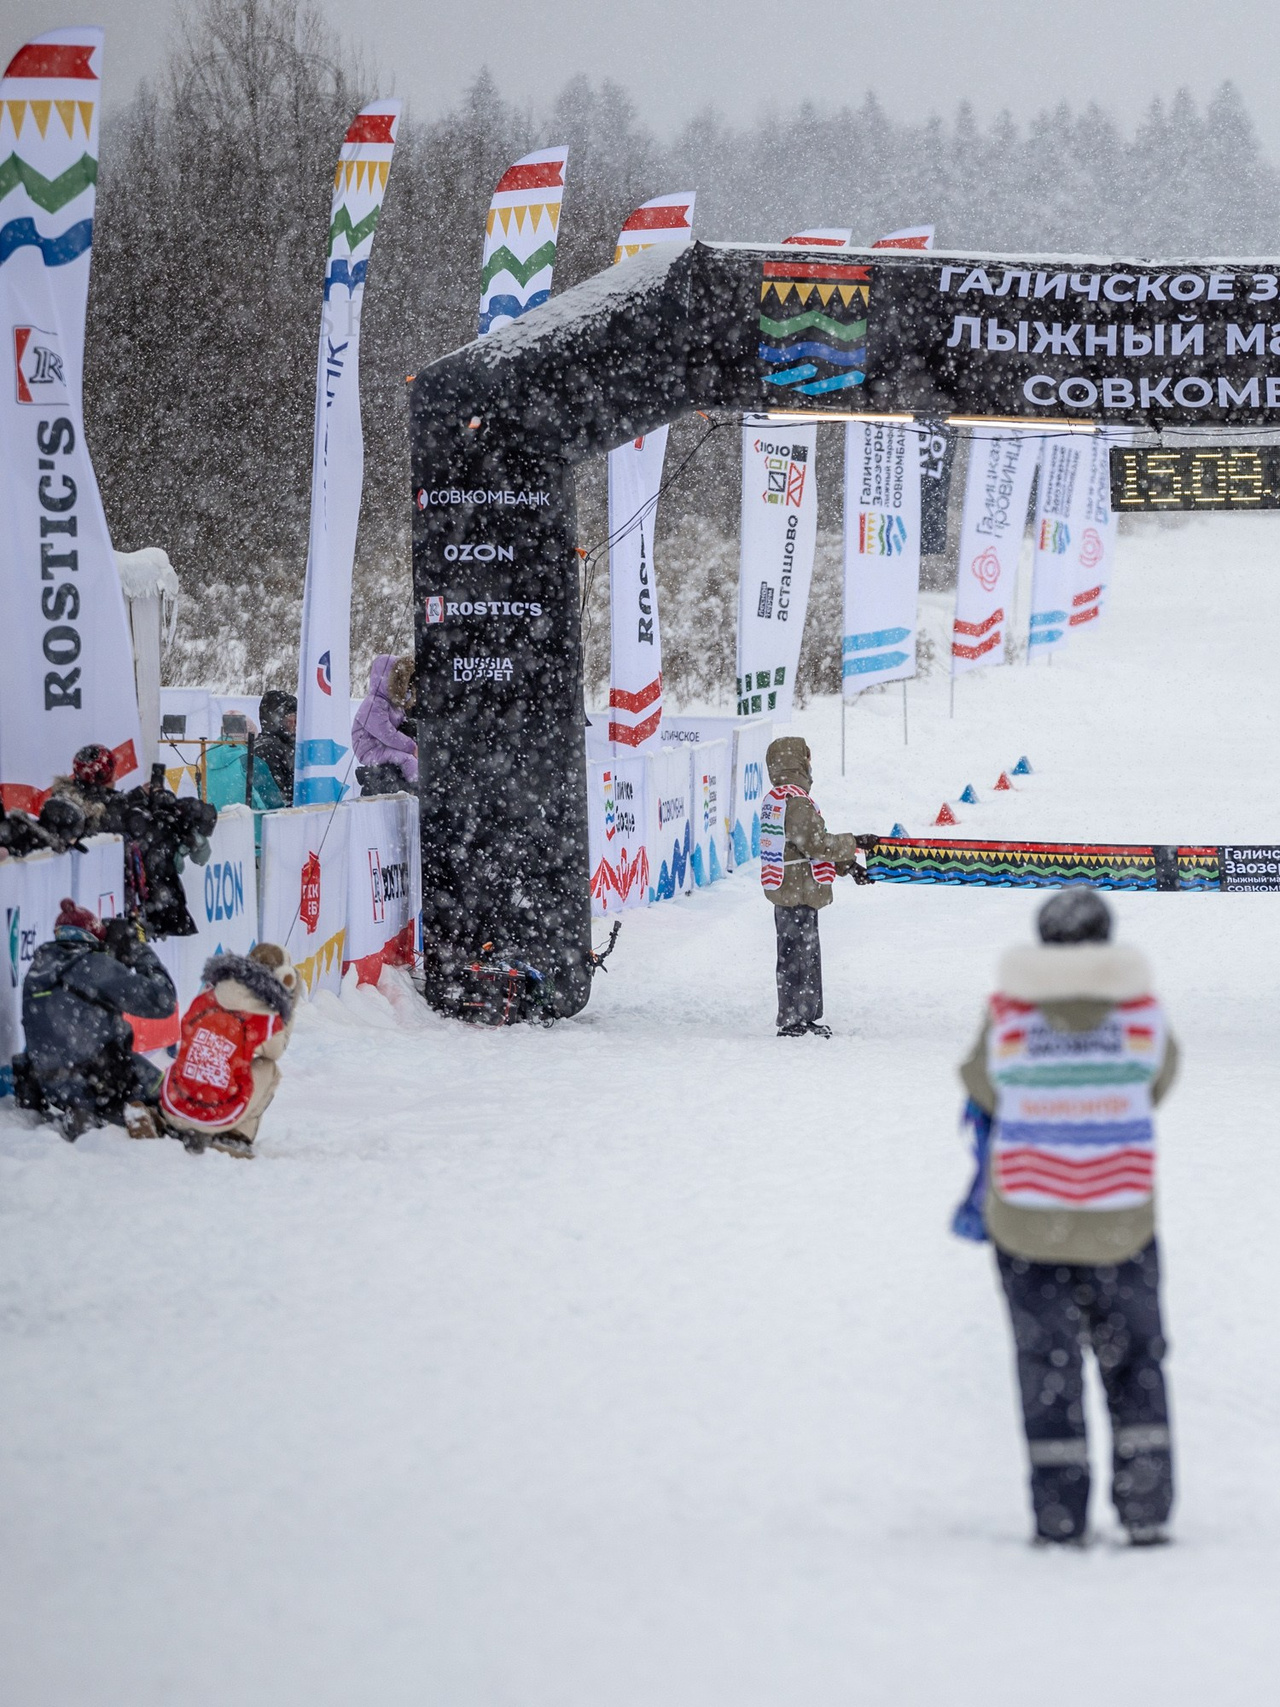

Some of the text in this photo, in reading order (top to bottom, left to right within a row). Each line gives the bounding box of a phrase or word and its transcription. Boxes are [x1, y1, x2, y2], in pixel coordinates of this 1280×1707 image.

[939, 267, 1235, 302] ГАЛИЧСКОЕ
[429, 489, 550, 506] СОВКОМБАНК
[444, 544, 514, 562] OZON
[37, 416, 83, 711] ROSTIC'S
[777, 513, 799, 622] асташово
[446, 601, 543, 617] ROSTIC'S
[453, 657, 514, 670] RUSSIA
[1227, 875, 1267, 884] лыжный
[204, 860, 244, 923] OZON
